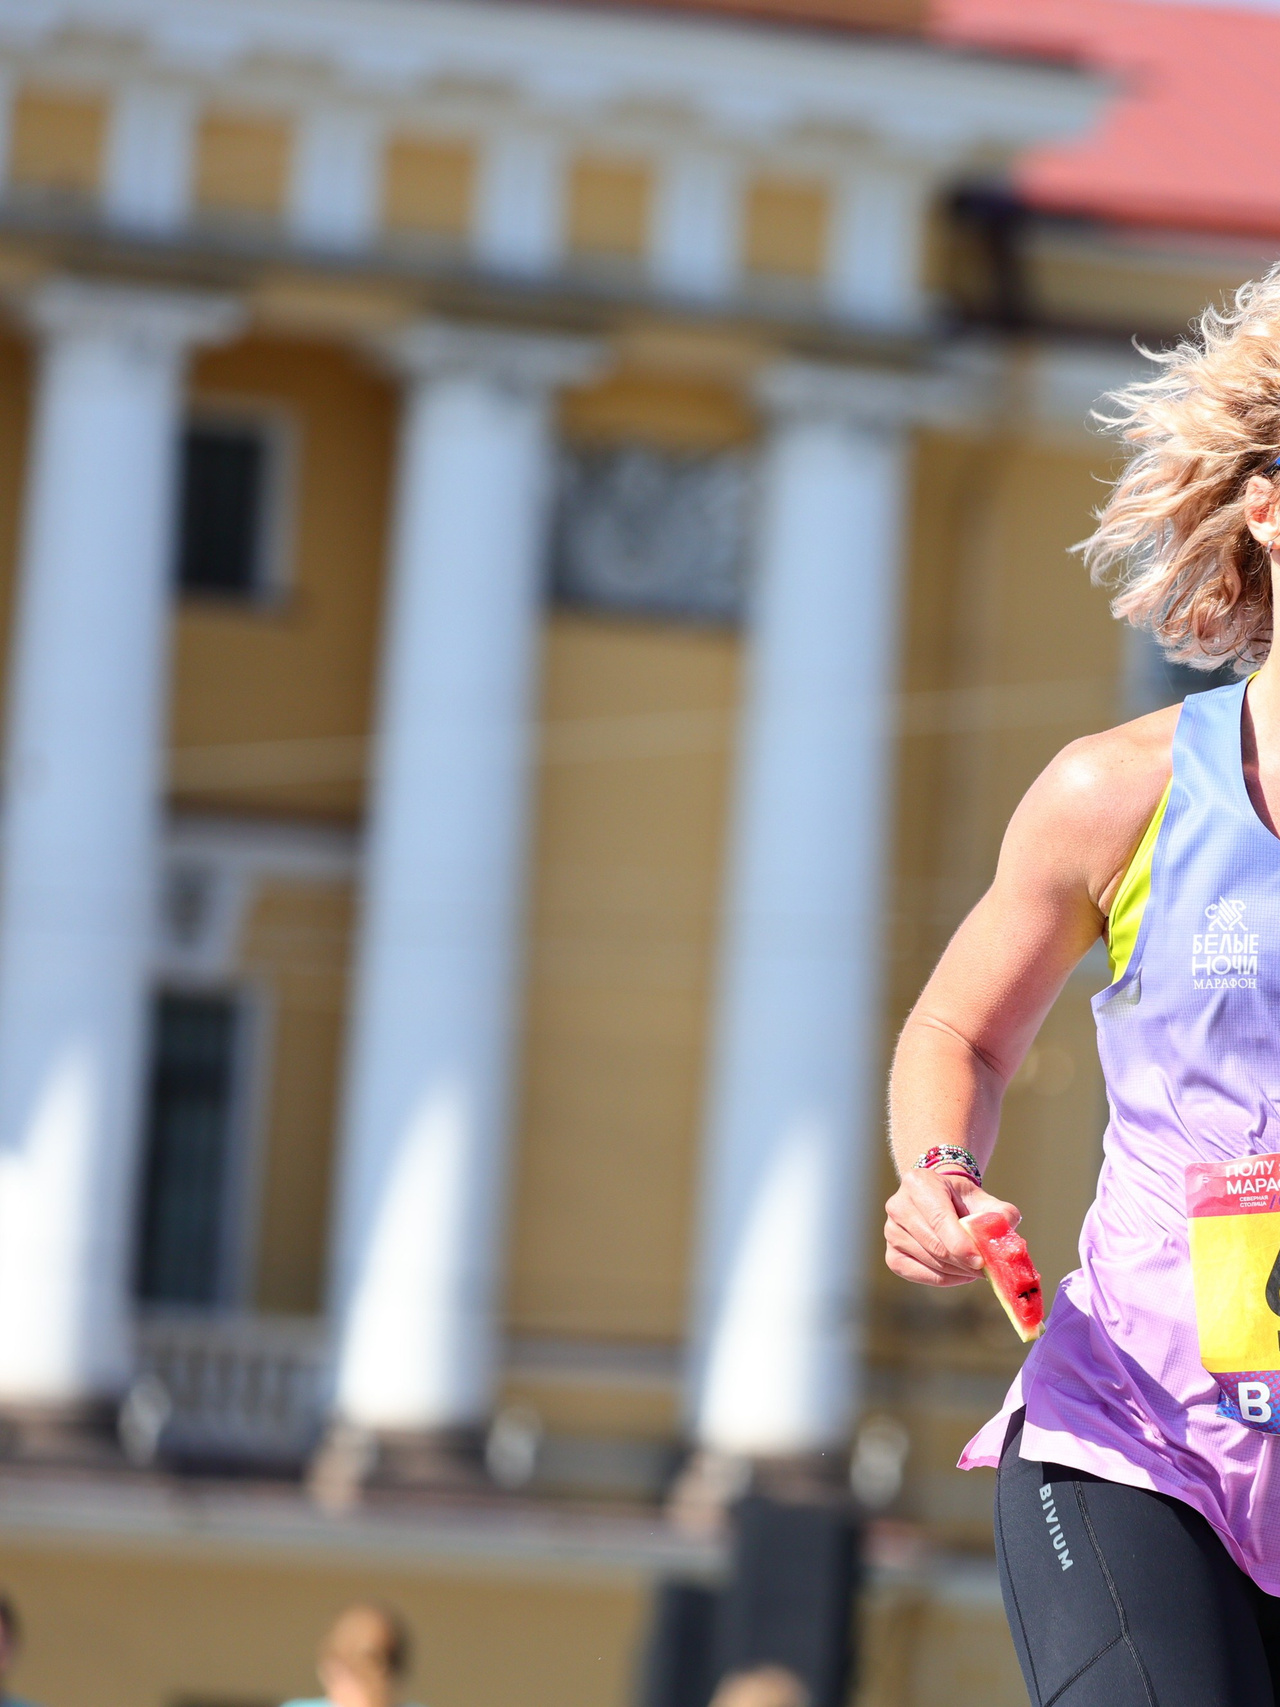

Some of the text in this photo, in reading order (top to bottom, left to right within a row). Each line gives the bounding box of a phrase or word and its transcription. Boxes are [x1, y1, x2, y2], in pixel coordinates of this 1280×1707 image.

[1191, 933, 1260, 955] БЕЛЫЕ
[1191, 955, 1258, 977] НОЧИ
[1193, 977, 1257, 990] МАРАФОН
[1225, 1159, 1276, 1178] ПОЛУ
[1039, 1482, 1074, 1572] BIVIUM
